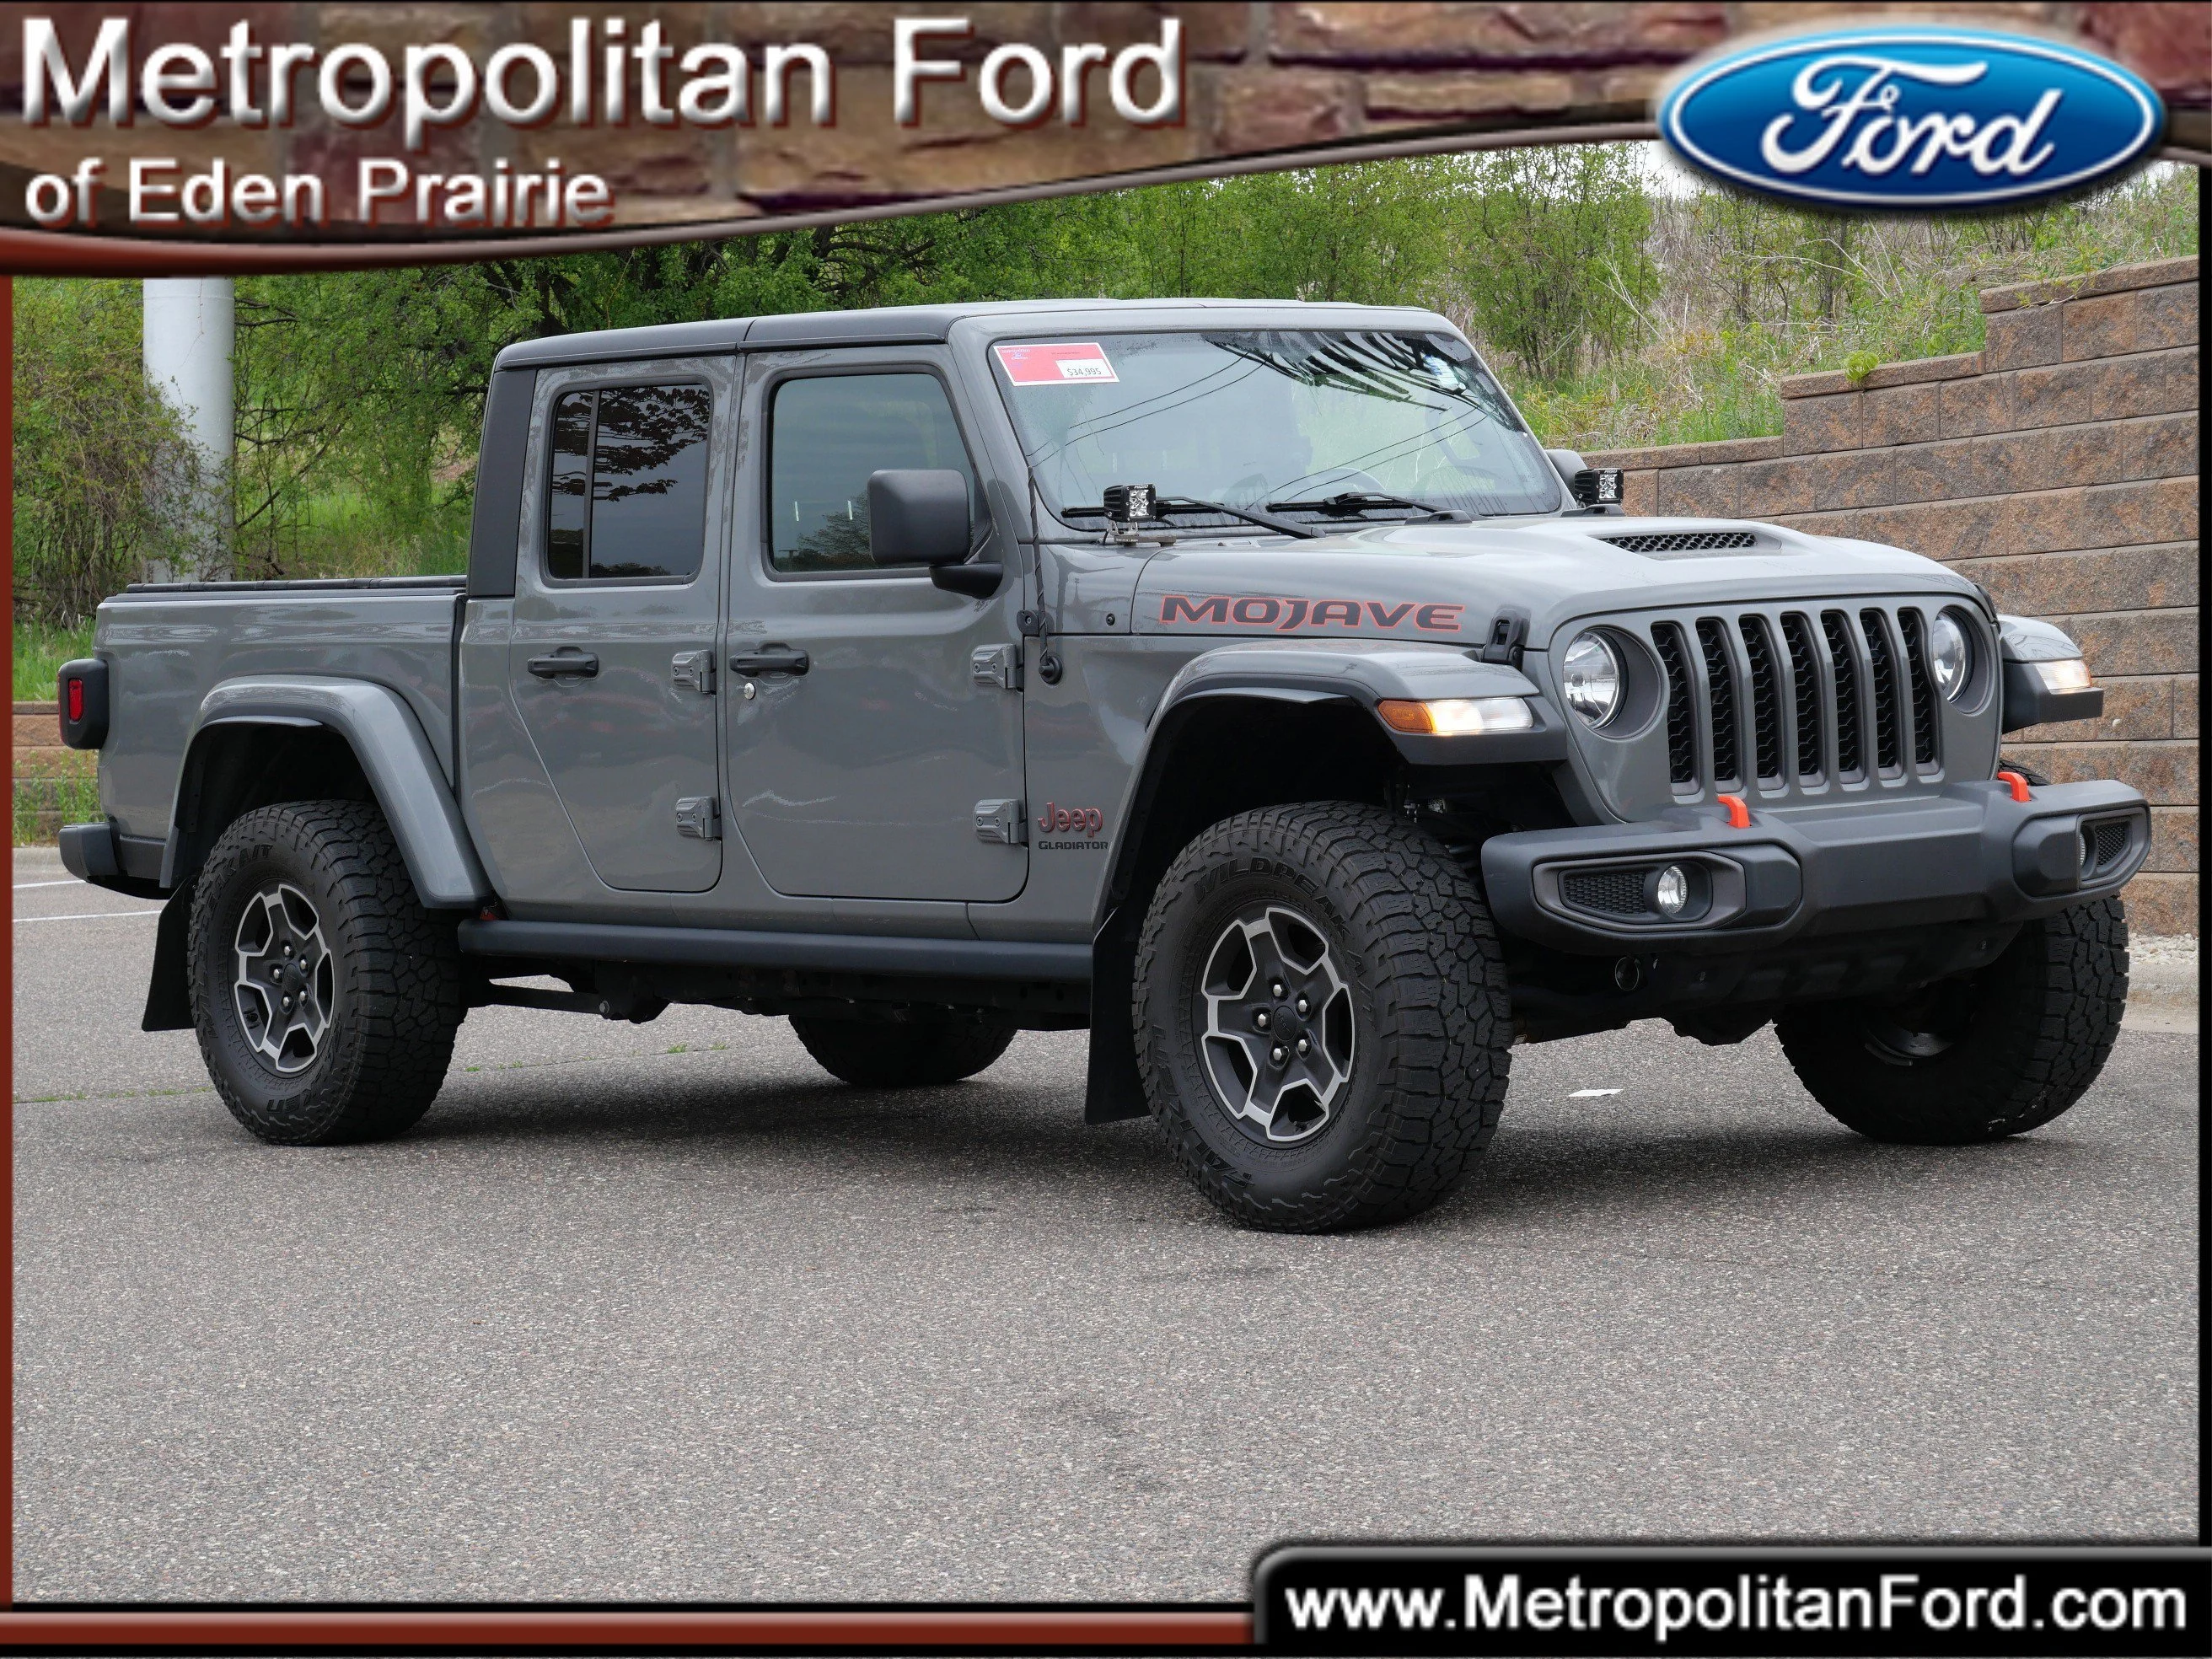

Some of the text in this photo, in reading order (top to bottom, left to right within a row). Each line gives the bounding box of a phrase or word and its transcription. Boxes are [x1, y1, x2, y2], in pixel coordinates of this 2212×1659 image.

[1067, 367, 1102, 377] $34,995
[1160, 595, 1466, 632] MOJAVE
[1038, 802, 1103, 837] Jeep
[1038, 840, 1109, 851] GLADIATOR
[1195, 856, 1354, 937] WILDPEAK
